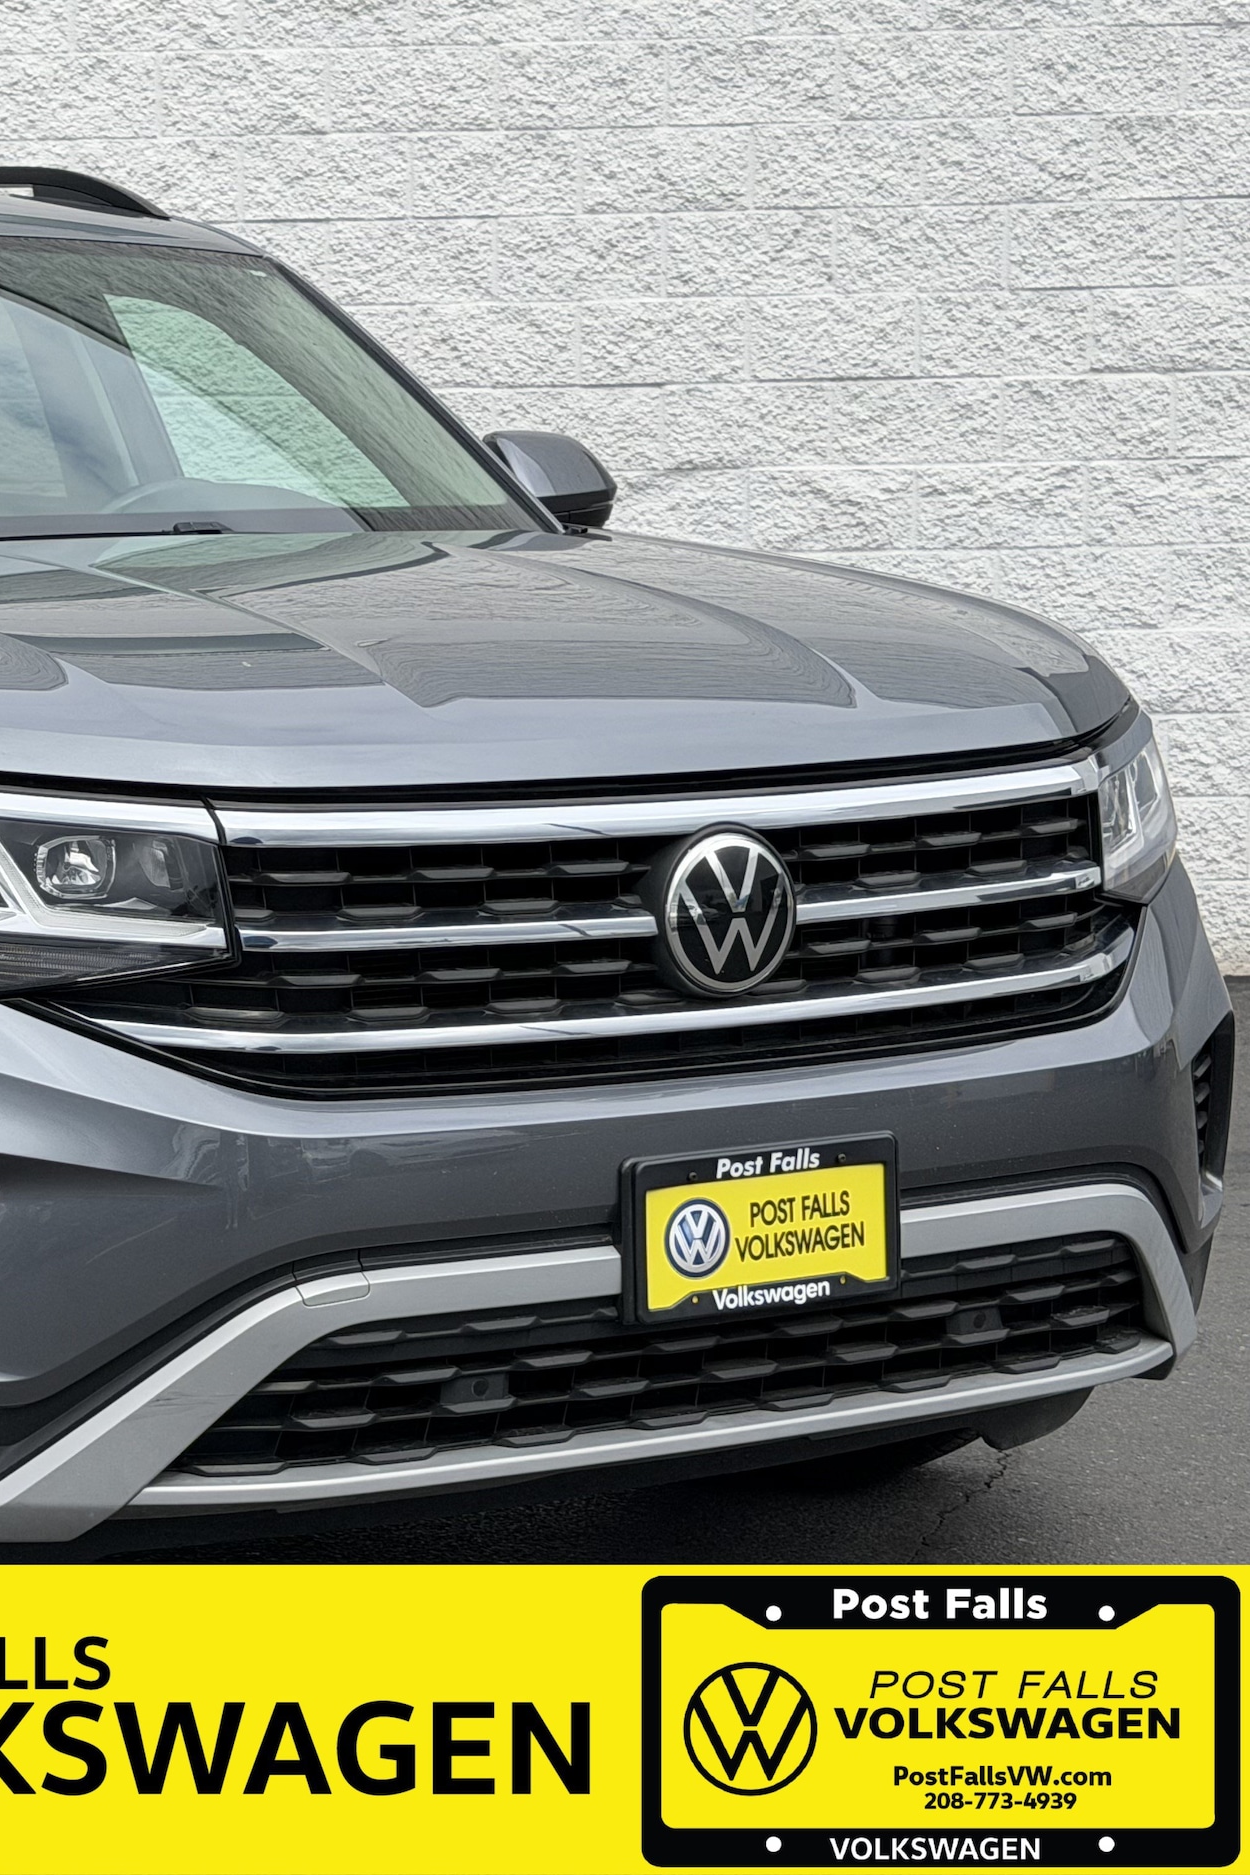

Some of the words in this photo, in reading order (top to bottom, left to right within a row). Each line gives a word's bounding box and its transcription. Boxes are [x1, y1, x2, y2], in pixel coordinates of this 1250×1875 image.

[716, 1156, 763, 1179] Post
[769, 1148, 821, 1173] Falls
[750, 1197, 796, 1228] POST
[801, 1190, 850, 1221] FALLS
[735, 1222, 865, 1263] VOLKSWAGEN
[712, 1280, 831, 1310] Volkswagen
